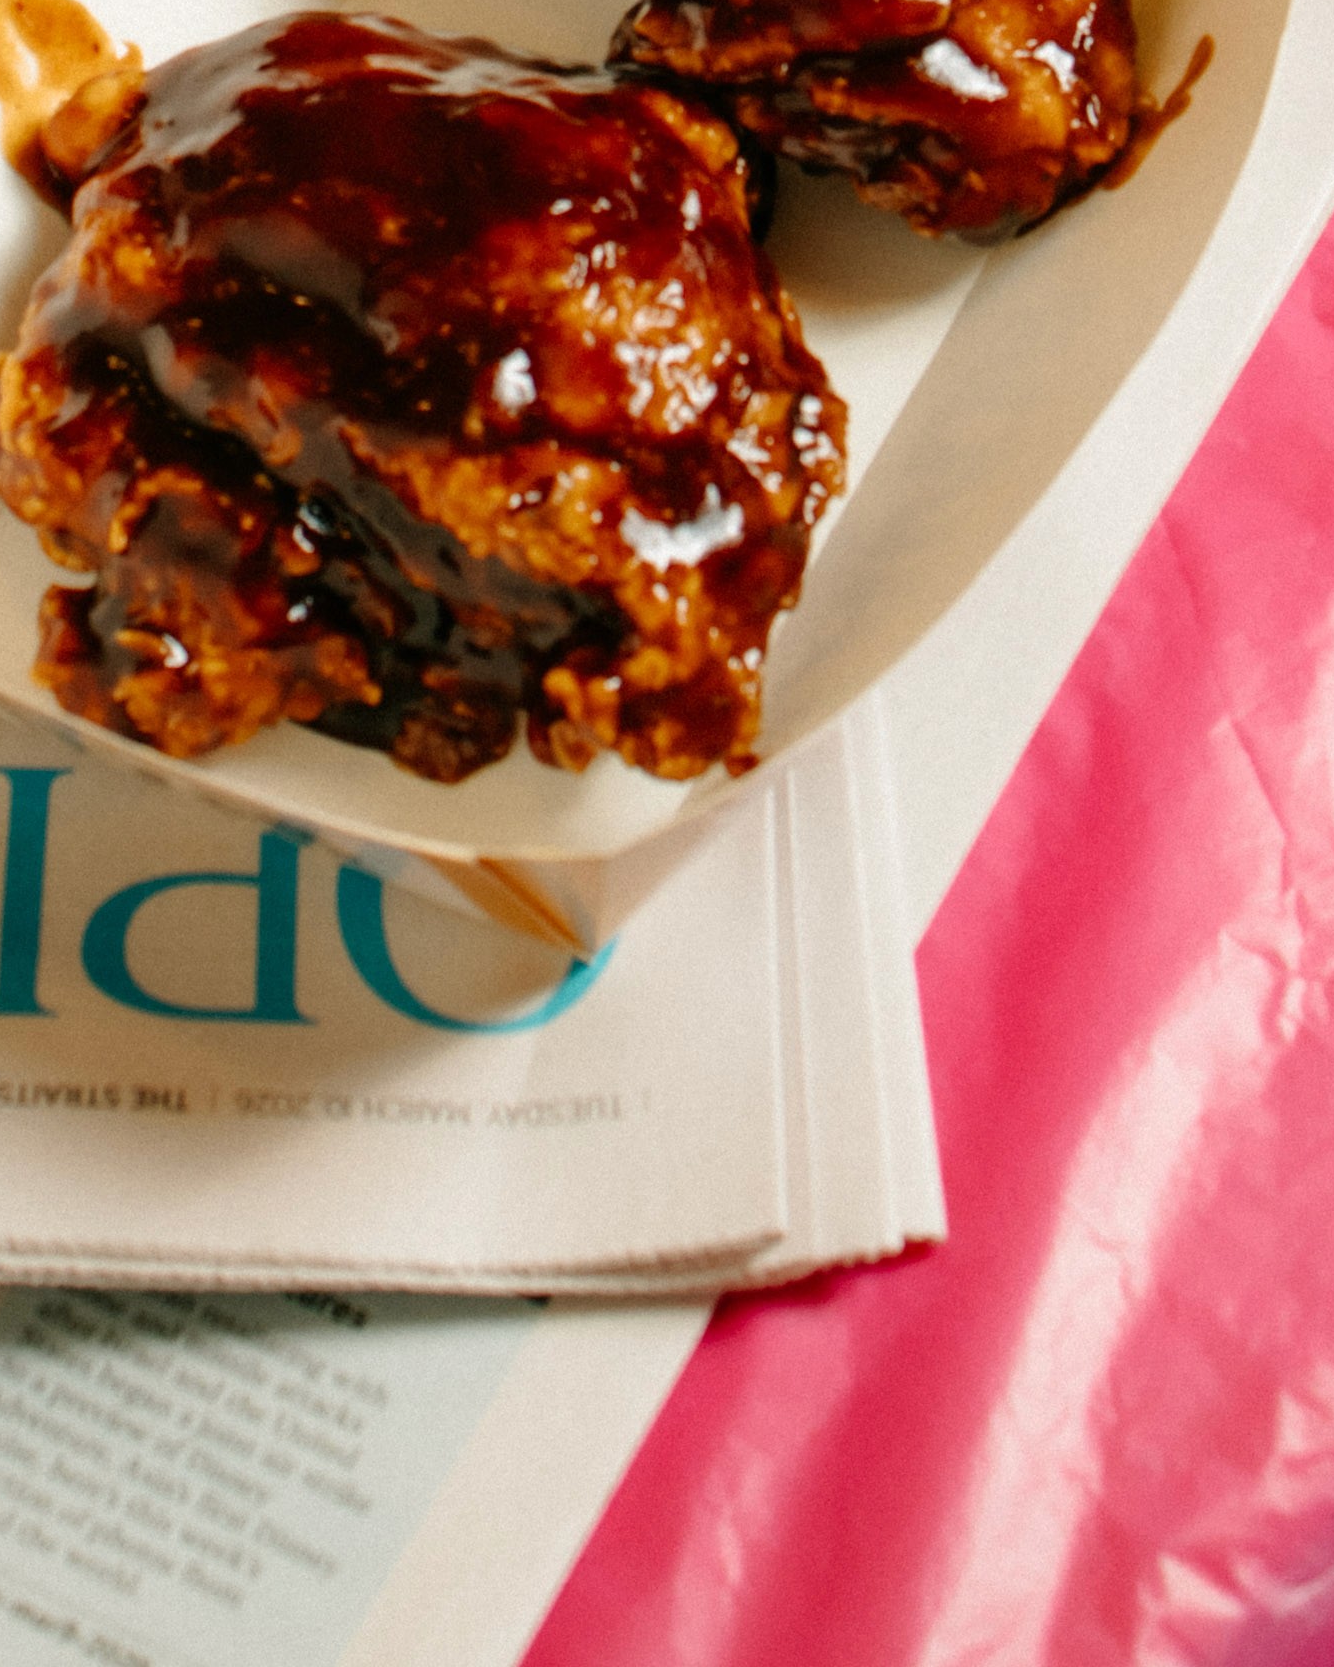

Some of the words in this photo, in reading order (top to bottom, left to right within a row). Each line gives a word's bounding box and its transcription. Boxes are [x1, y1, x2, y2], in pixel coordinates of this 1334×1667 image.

[133, 1090, 187, 1116] THE
[236, 1092, 312, 1121] 2026
[366, 1096, 472, 1124] MARCH
